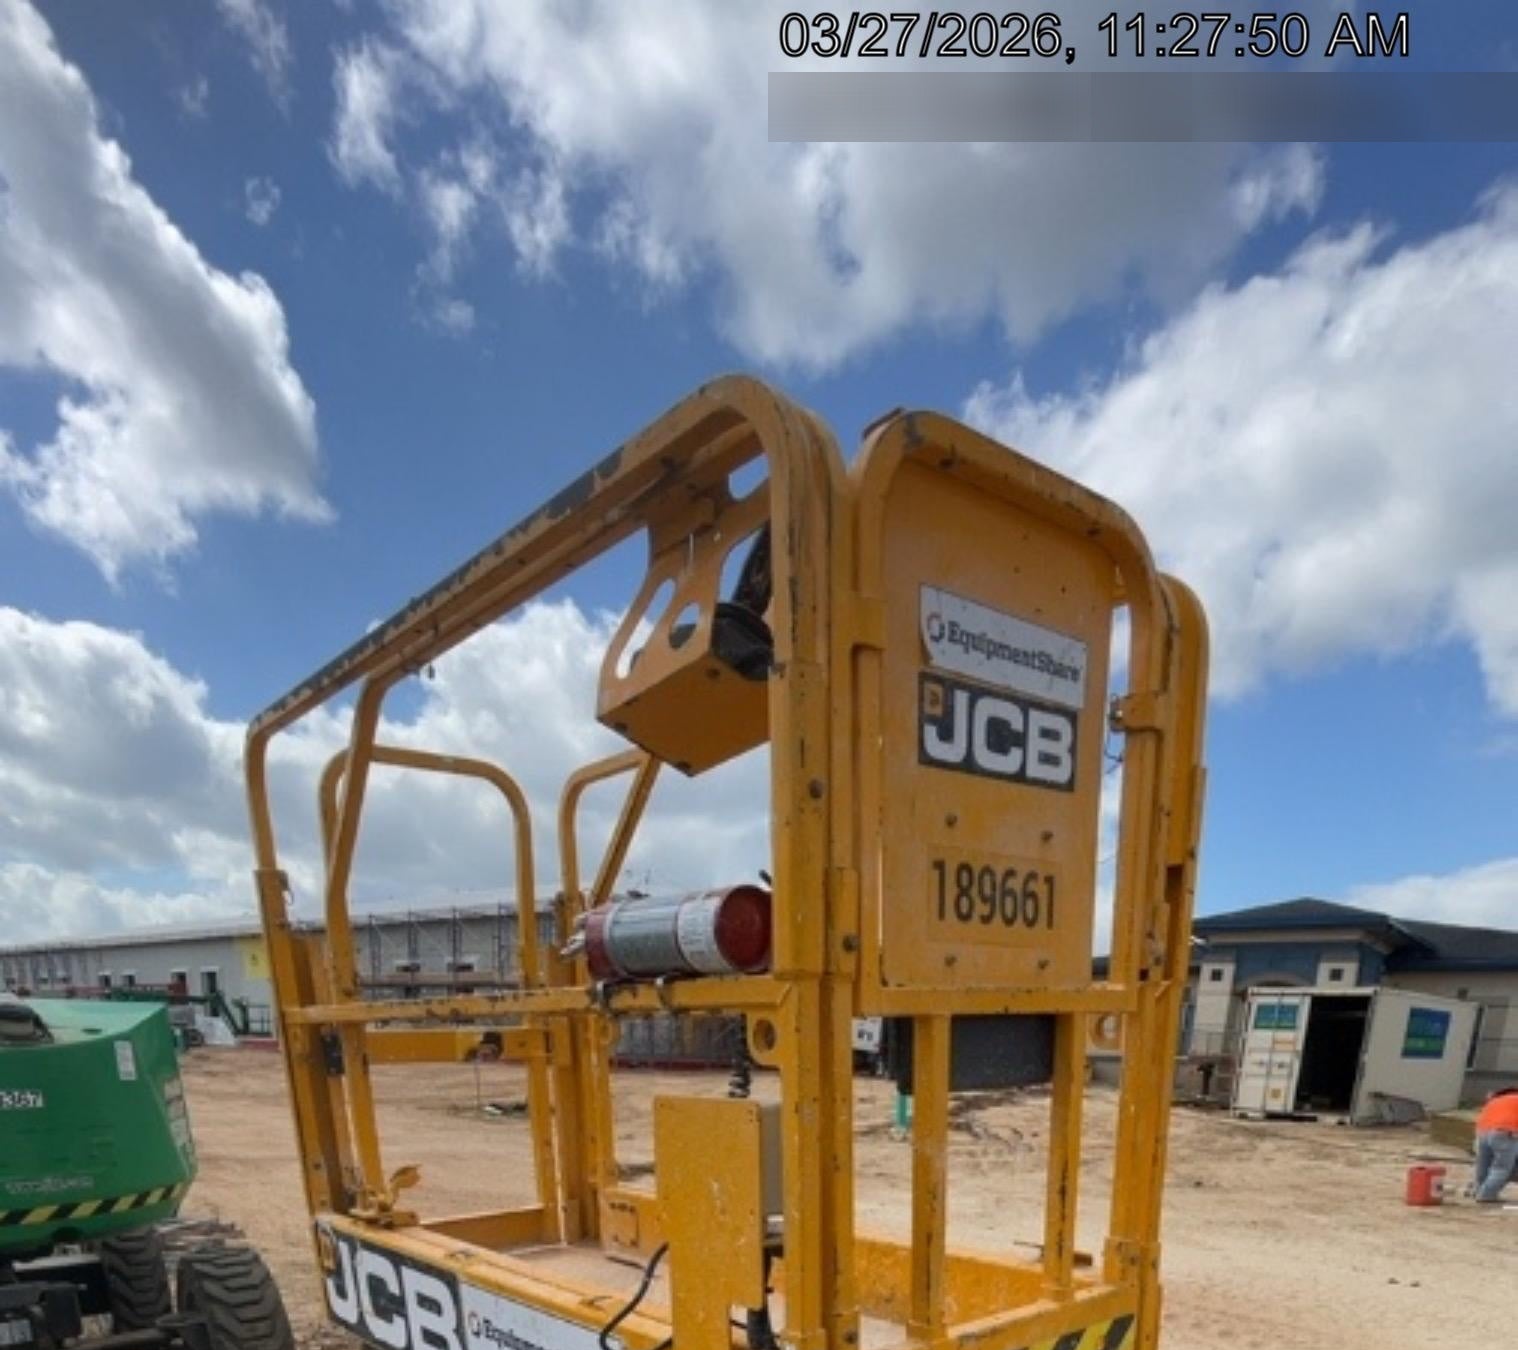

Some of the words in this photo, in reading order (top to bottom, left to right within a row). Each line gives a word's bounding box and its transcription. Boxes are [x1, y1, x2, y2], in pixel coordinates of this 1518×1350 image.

[947, 619, 1080, 684] EquipmentShare
[923, 688, 1073, 784] JCB
[932, 858, 1055, 931] 189661
